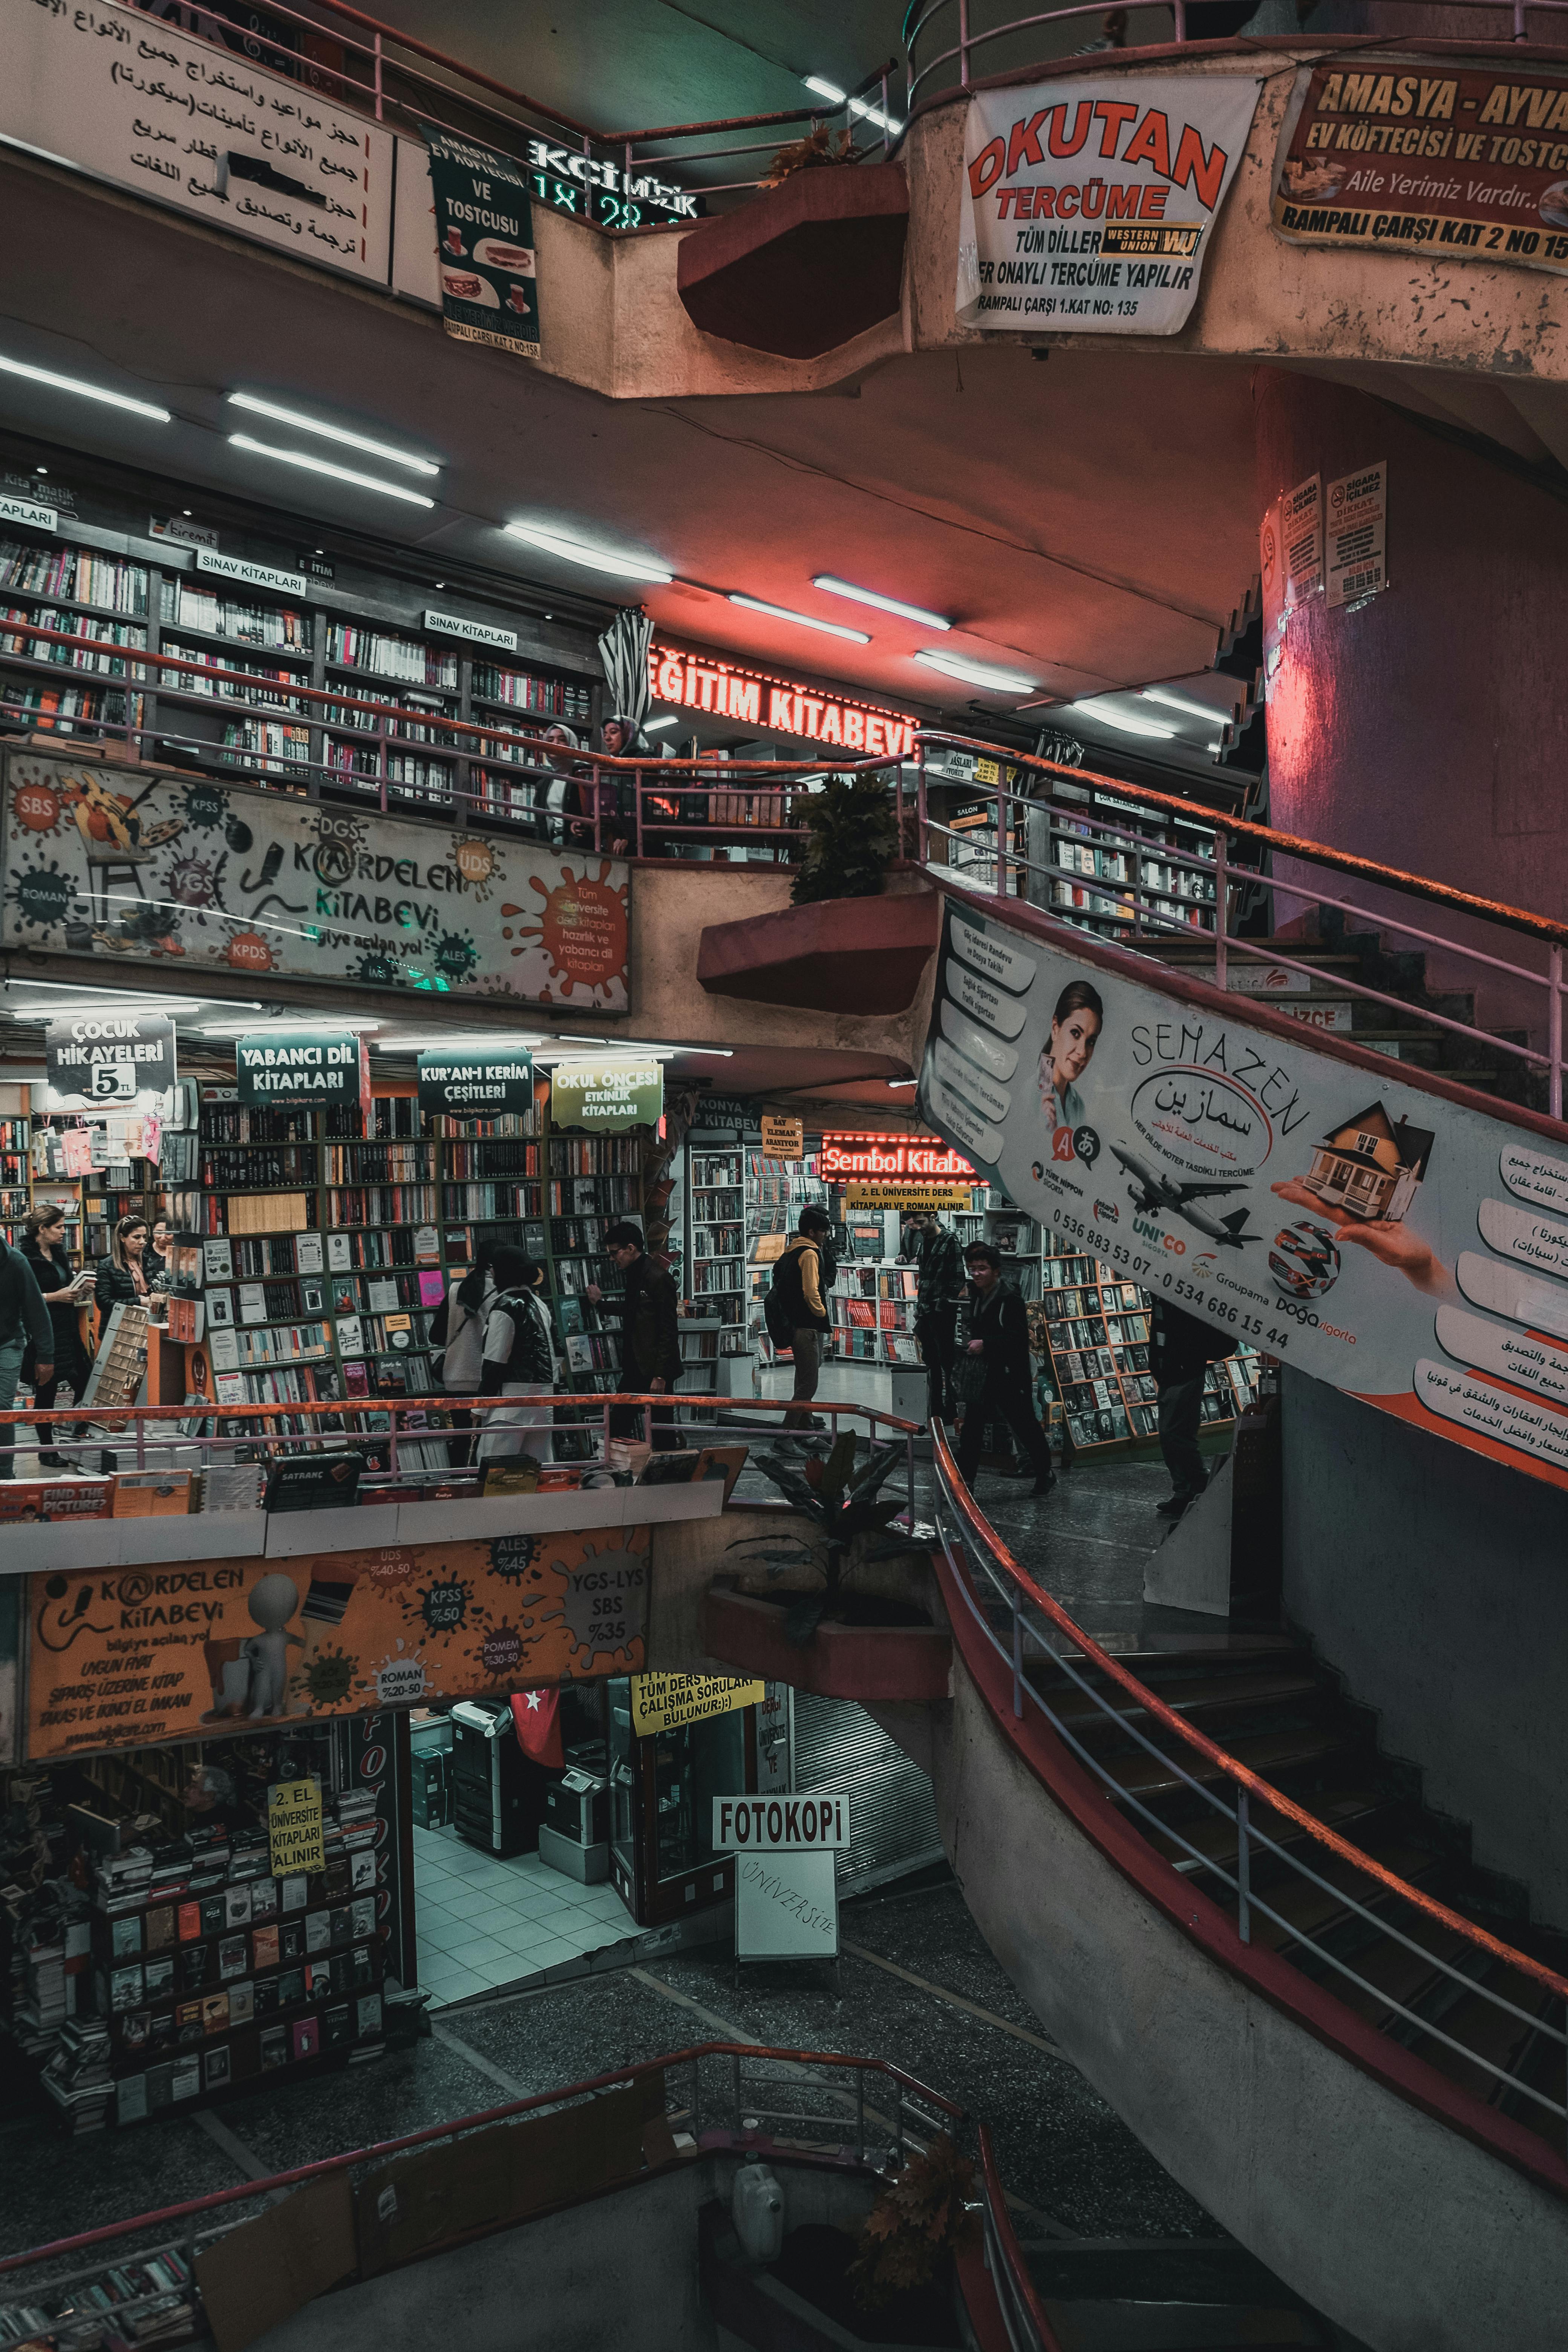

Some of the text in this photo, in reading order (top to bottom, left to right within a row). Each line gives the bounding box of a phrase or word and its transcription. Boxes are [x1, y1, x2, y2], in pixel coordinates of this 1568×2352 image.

[75, 9, 359, 146] حجز مواعيد واستخراج جميع الأنواع
[1317, 74, 1458, 119] AMASYA
[133, 116, 176, 144] سريع
[1306, 120, 1487, 161] EV KÖFTECİSİ VE
[261, 128, 358, 181] جميع الأنواع
[968, 101, 1228, 213] OKUTAN
[472, 179, 492, 201] VE
[1346, 171, 1461, 200] Aile Yerimiz
[130, 152, 355, 254] ترجمة وتصديق اللغات
[995, 178, 1170, 219] TERCÜME
[446, 198, 519, 236] TOSTCUSU
[1016, 225, 1102, 254] TÜM DİLLER
[1108, 230, 1159, 241] WESTERN
[1282, 207, 1540, 256] RAMPALI ÇARŞI KAT 2 NO
[1120, 241, 1156, 251] UNION
[1163, 231, 1196, 253] WU
[997, 260, 1193, 290] ONAYLI TERCÜME YAPILIR
[978, 296, 1138, 316] RAMPALI ÇARŞI 1.KAT NO: 135
[494, 335, 513, 349] KAT 2
[1346, 472, 1380, 491] SİGARA
[202, 555, 302, 592] SINAV KİTAPLARI
[430, 615, 513, 646] SINAV KİTAPLARI
[769, 684, 916, 756] KİTABEVİ
[20, 796, 53, 816] SBS
[192, 800, 218, 812] KPSS
[957, 806, 978, 816] SALON
[320, 817, 359, 839] DGS
[460, 852, 490, 873] ÜDS
[173, 873, 214, 893] YGS
[23, 888, 66, 903] ROMAN
[578, 887, 597, 900] Tüm
[233, 942, 266, 959] KPDS
[442, 950, 466, 961] ALES
[559, 945, 613, 959] yabancı dil
[989, 944, 1012, 964] Randevu
[988, 958, 1003, 974] Takibi
[72, 1019, 141, 1043] ÇOCUK
[57, 1040, 164, 1065] HİKAYELERİ
[242, 1043, 355, 1066] YABANCI DİL
[96, 1069, 119, 1094] 5
[254, 1070, 343, 1090] KİTAPLARI
[486, 1063, 528, 1080] KERİM
[557, 1069, 658, 1089] OKUL ÖNCESİ
[1132, 1024, 1310, 1136] SEMAZEN
[444, 1083, 506, 1102] ÇEŞİTLERİ
[585, 1089, 631, 1102] ETKİNLİK
[582, 1104, 637, 1116] KİTAPLARI
[699, 1099, 742, 1113] KONYA
[1155, 1081, 1251, 1136] سمازين
[766, 1139, 799, 1147] ARANIYOR
[1134, 1119, 1255, 1177] HER DİLDE NOTER TASDİKLİ TERCÜME
[1193, 1136, 1237, 1162] مكتب للخدمات
[827, 1148, 903, 1172] Sembol
[1508, 1157, 1531, 1170] جميع
[1045, 1168, 1060, 1184] TÜRK
[883, 1187, 930, 1196] ÜNİVERSİTE
[932, 1188, 953, 1197] DERS
[850, 1200, 892, 1210] KİTAPLARI
[1094, 1198, 1115, 1213] Ankara
[1097, 1207, 1119, 1224] Sigorta
[1054, 1209, 1289, 1349] 0 536 883 53 07 0 534 686 15 44
[1216, 1273, 1269, 1306] Groupama
[1502, 1341, 1545, 1365] والتصديق
[1508, 1362, 1539, 1381] اللغات
[1539, 1377, 1565, 1393] جميع
[1427, 1371, 1542, 1427] العقارات والشقق في قونيا
[1463, 1407, 1502, 1429] الخدمات
[43, 1487, 106, 1501] FIND THE
[43, 1499, 107, 1513] PICTURE?
[497, 1537, 528, 1552] ALES
[381, 1550, 401, 1562] ÜDS
[497, 1557, 527, 1571] %45
[371, 1563, 410, 1577] %40-50
[572, 1568, 645, 1593] YGS-LYS
[430, 1588, 462, 1604] KPSS
[430, 1608, 460, 1623] %50
[593, 1597, 623, 1616] SBS
[191, 1629, 210, 1645] yol
[589, 1622, 626, 1641] %35
[484, 1639, 520, 1653] POMEM
[484, 1652, 519, 1665] %30-50
[381, 1669, 422, 1684] ROMAN
[382, 1683, 421, 1698] %20-50
[639, 1681, 666, 1700] TÜM
[670, 1675, 700, 1693] DERS
[79, 1699, 147, 1721] VE EL
[639, 1689, 694, 1719] ÇALIŞMA
[767, 1756, 777, 1774] VE
[276, 1788, 312, 1806] 2. EL
[271, 1806, 318, 1828] ÜNİVERSİTE
[720, 1801, 842, 1844] FOTOKOPİ
[273, 1826, 320, 1848] KİTAPLARI
[274, 1846, 320, 1868] ALINIR
[742, 1862, 835, 1935] ÜNİVERSİTE
